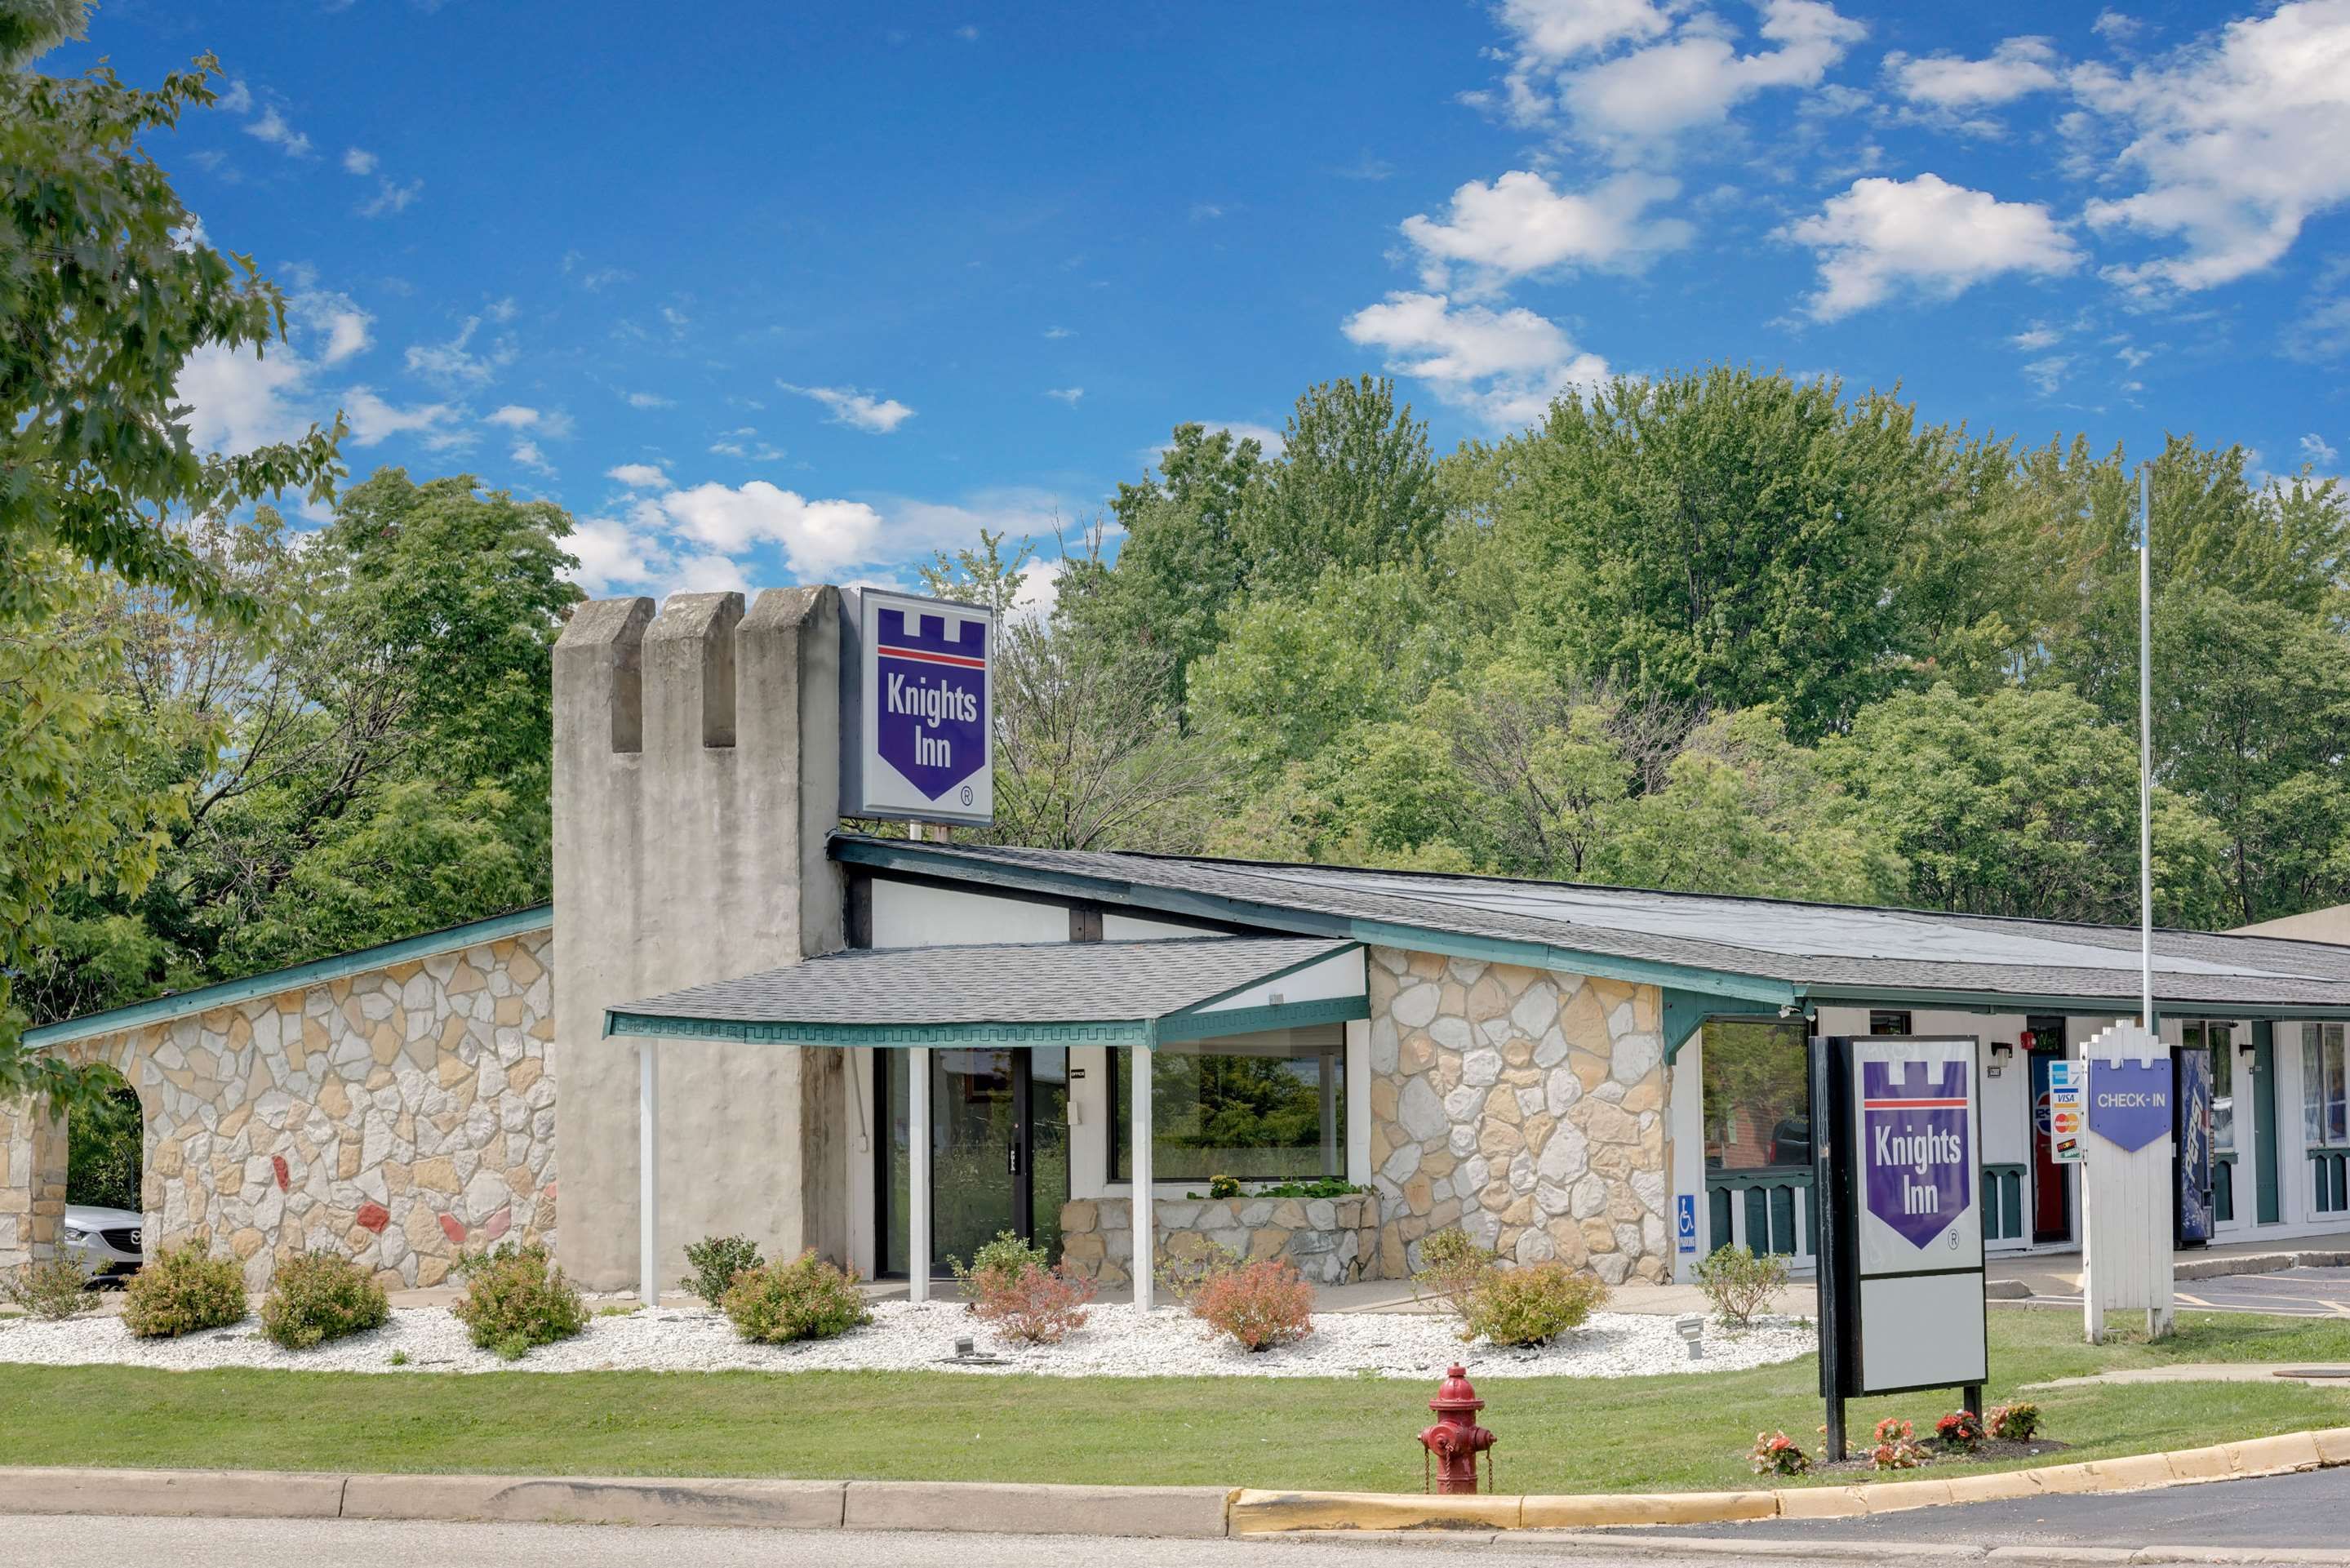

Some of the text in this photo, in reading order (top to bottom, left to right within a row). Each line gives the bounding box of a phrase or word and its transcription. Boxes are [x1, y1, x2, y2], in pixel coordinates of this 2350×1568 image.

[887, 672, 977, 729] Knights
[915, 725, 951, 768] Inn
[2058, 1094, 2075, 1103] VISA
[2098, 1093, 2166, 1108] CHECK-IN
[1875, 1125, 1961, 1174] Knights
[2185, 1085, 2204, 1184] PEPSI
[1904, 1175, 1939, 1215] Inn
